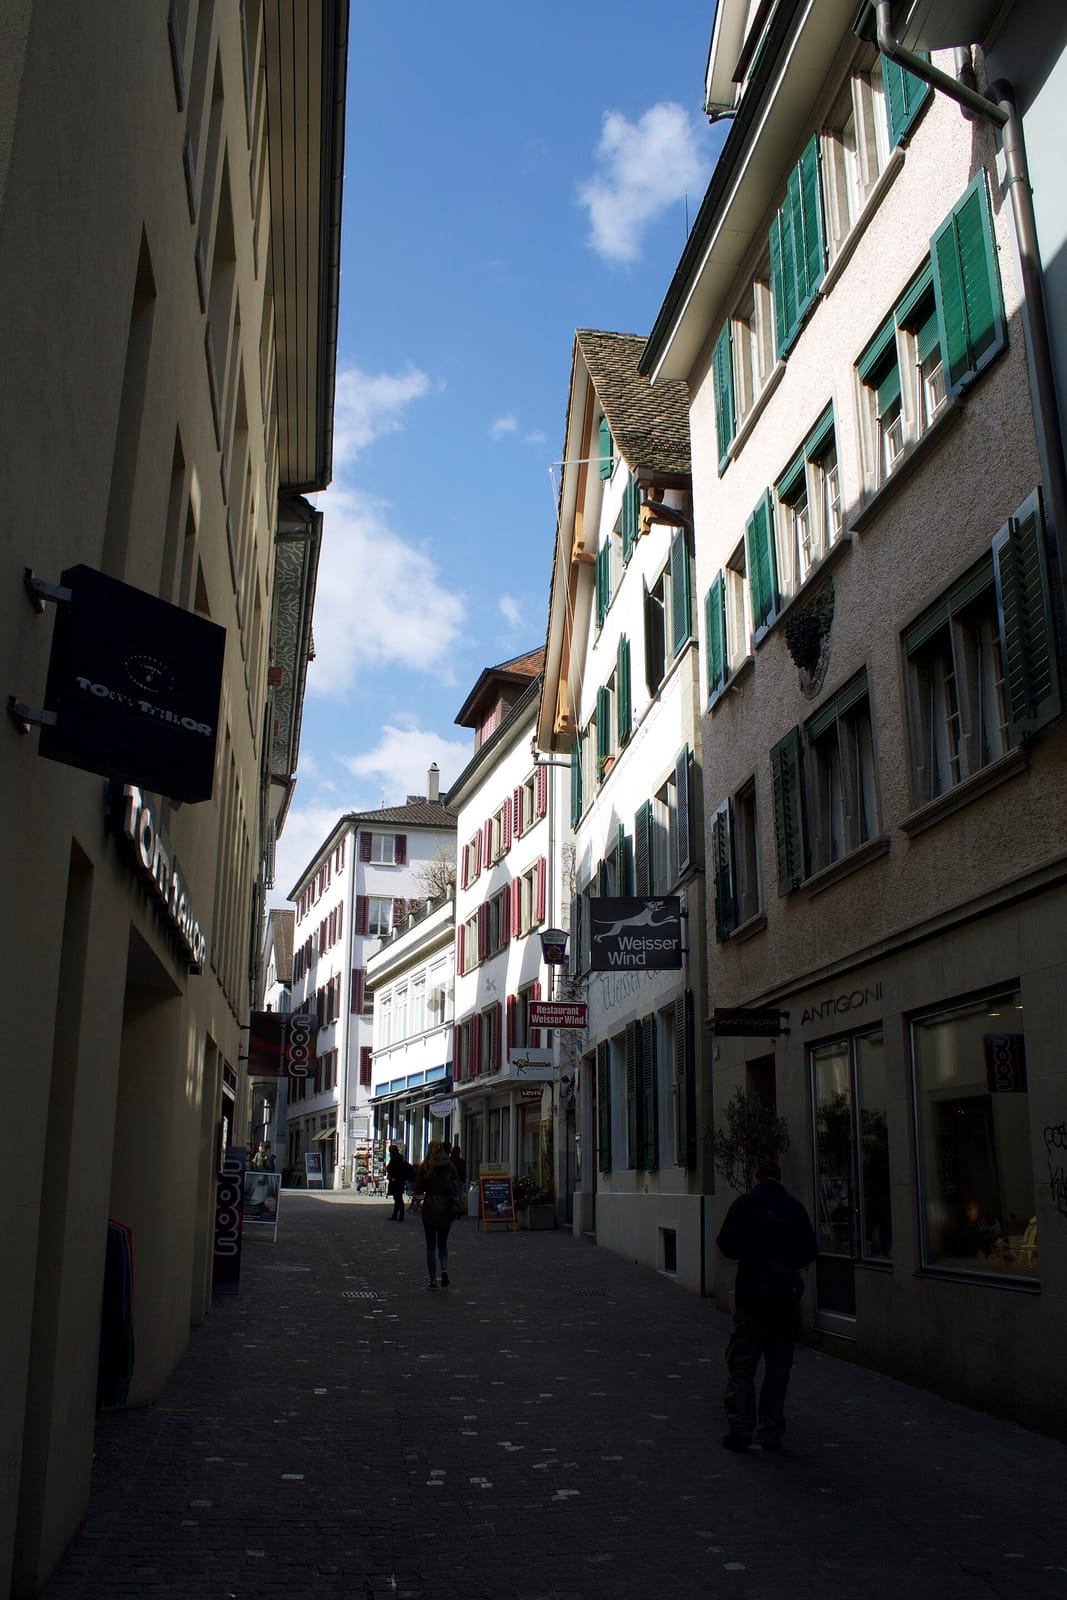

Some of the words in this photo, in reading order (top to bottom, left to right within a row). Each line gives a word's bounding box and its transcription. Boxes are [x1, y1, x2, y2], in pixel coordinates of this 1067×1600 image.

[618, 936, 679, 951] Weisser
[608, 951, 646, 966] Wind
[536, 1005, 580, 1015] Restaurant
[801, 982, 883, 1025] ANTIGONI
[531, 1015, 564, 1025] Weisser
[565, 1015, 585, 1026] Wind
